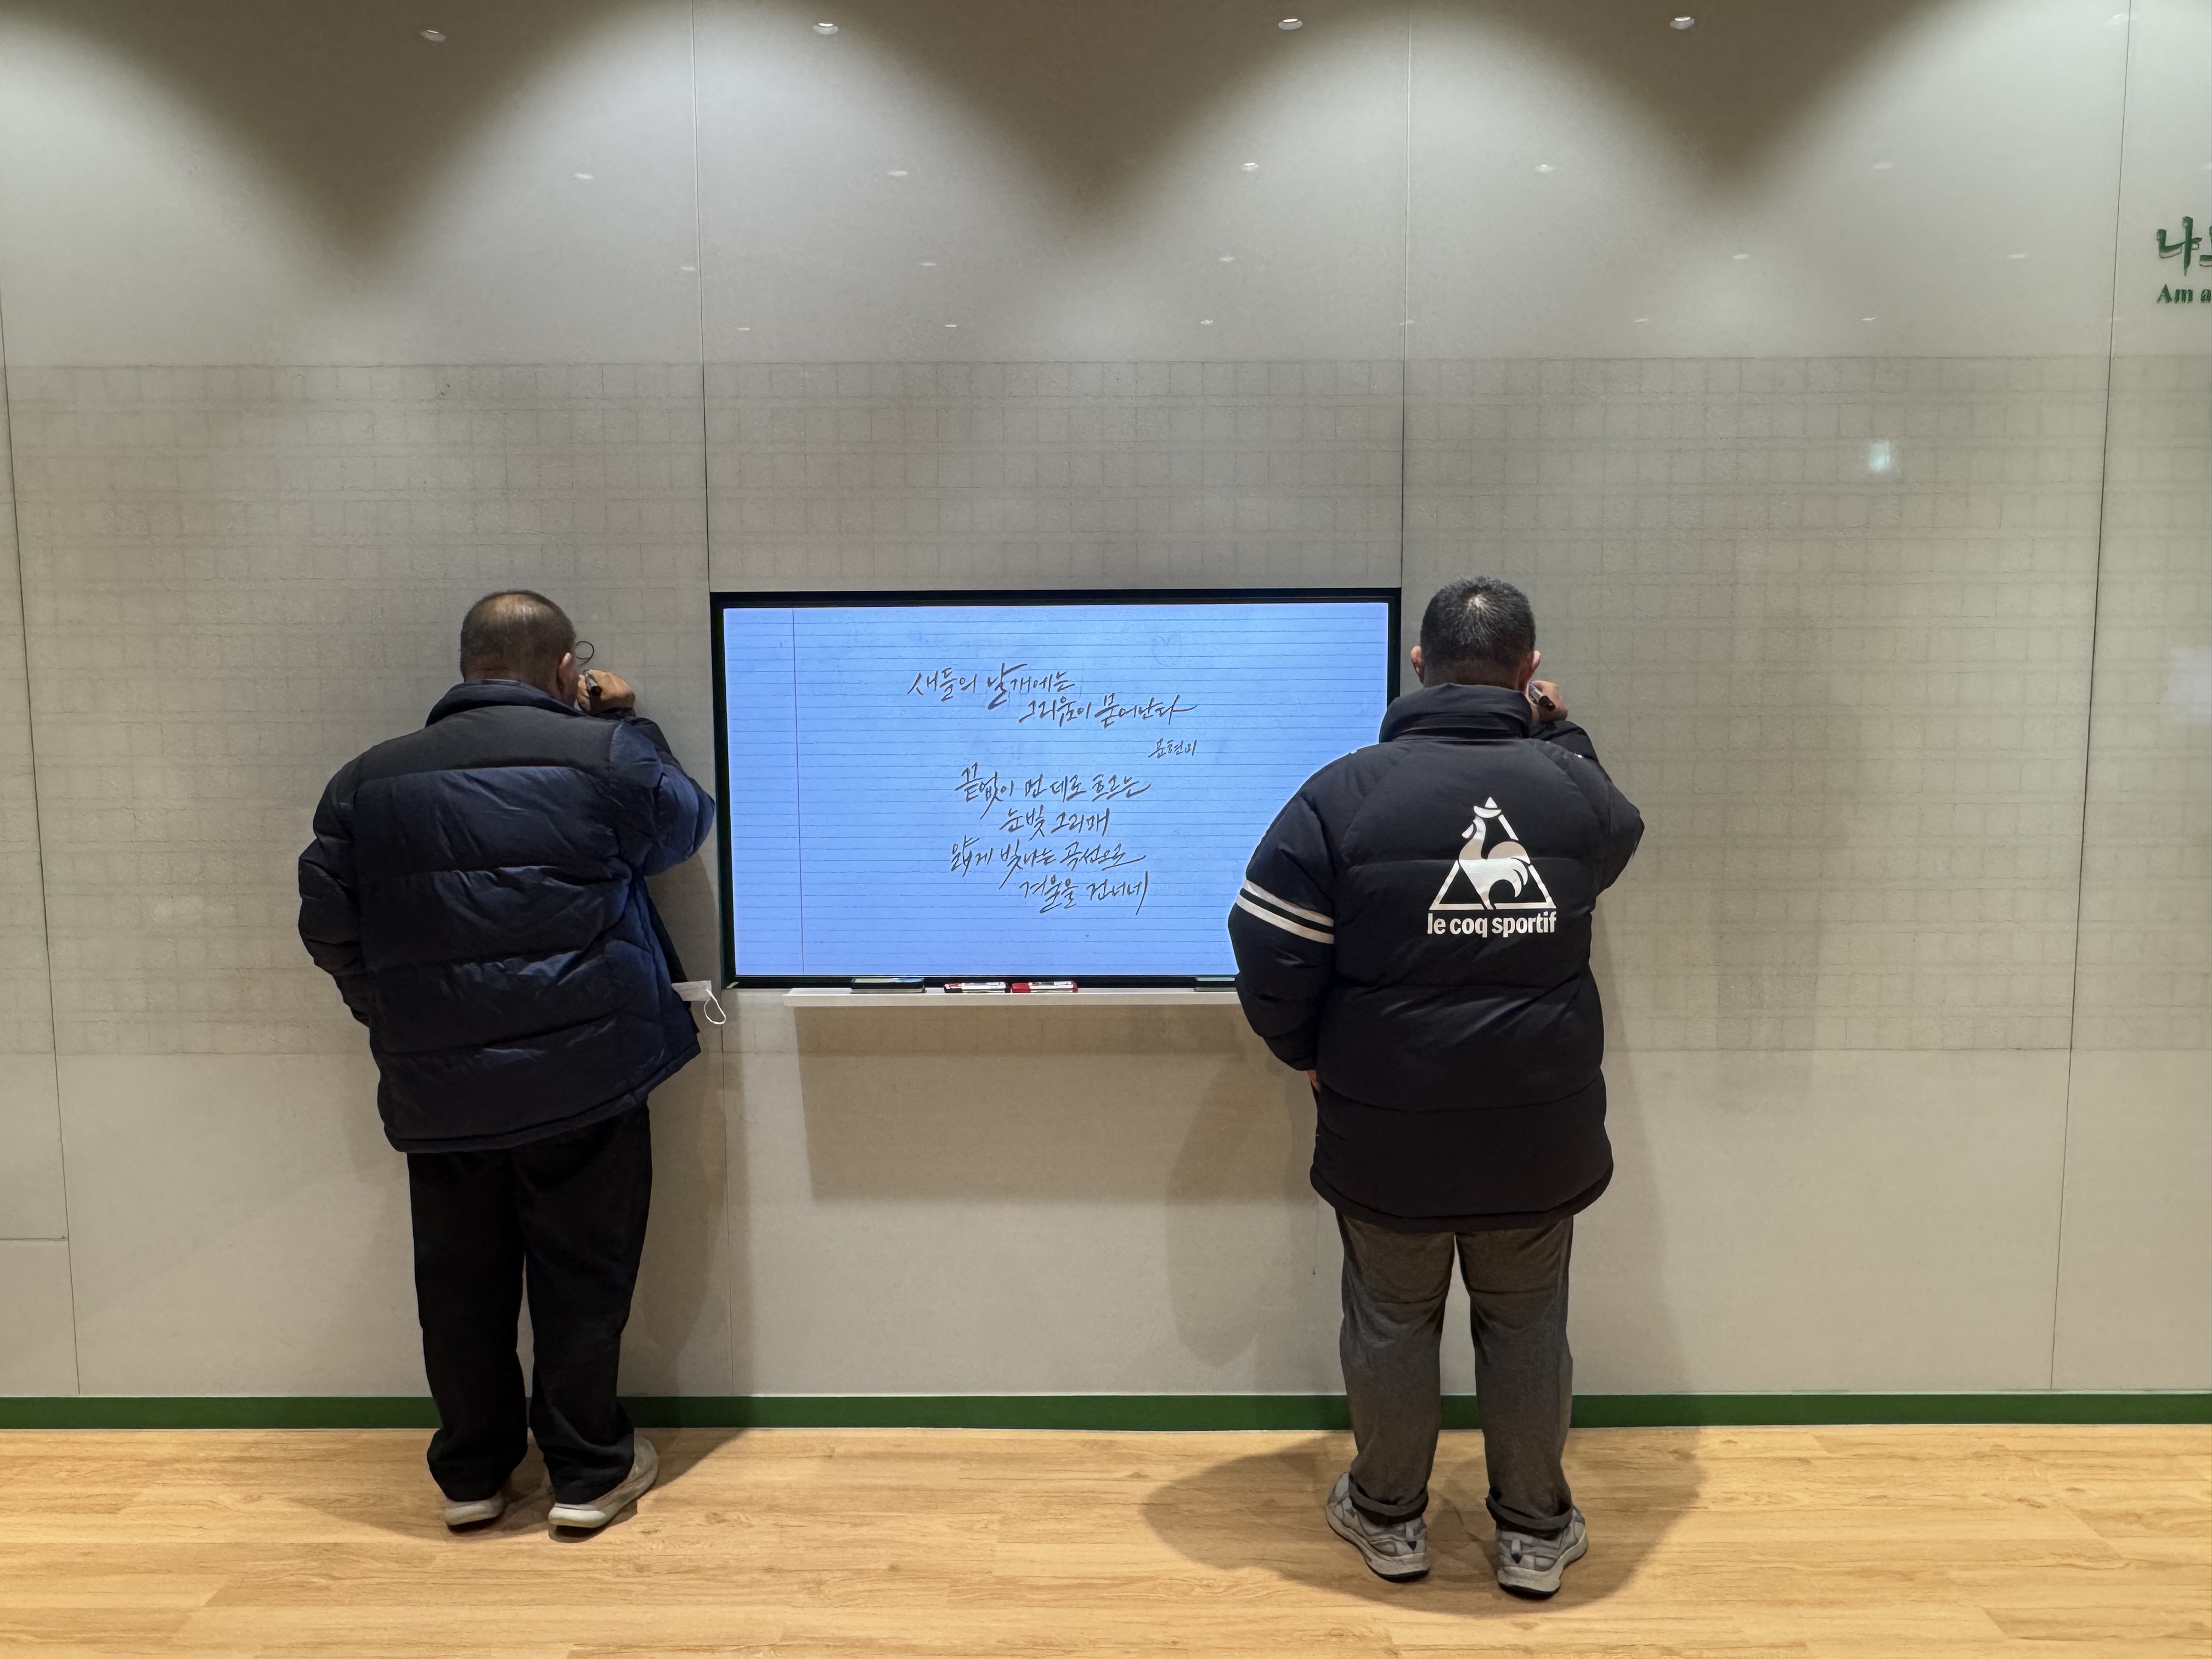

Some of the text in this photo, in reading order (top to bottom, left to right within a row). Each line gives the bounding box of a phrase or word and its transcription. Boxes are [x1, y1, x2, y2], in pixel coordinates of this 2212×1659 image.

[2156, 216, 2212, 277] 나
[2157, 284, 2193, 304] Am
[907, 662, 1075, 710] 새들의 날개에는
[1018, 696, 1092, 728] 그리움이
[1092, 774, 1152, 803] 흐르는
[1427, 911, 1557, 938] le coq sportif
